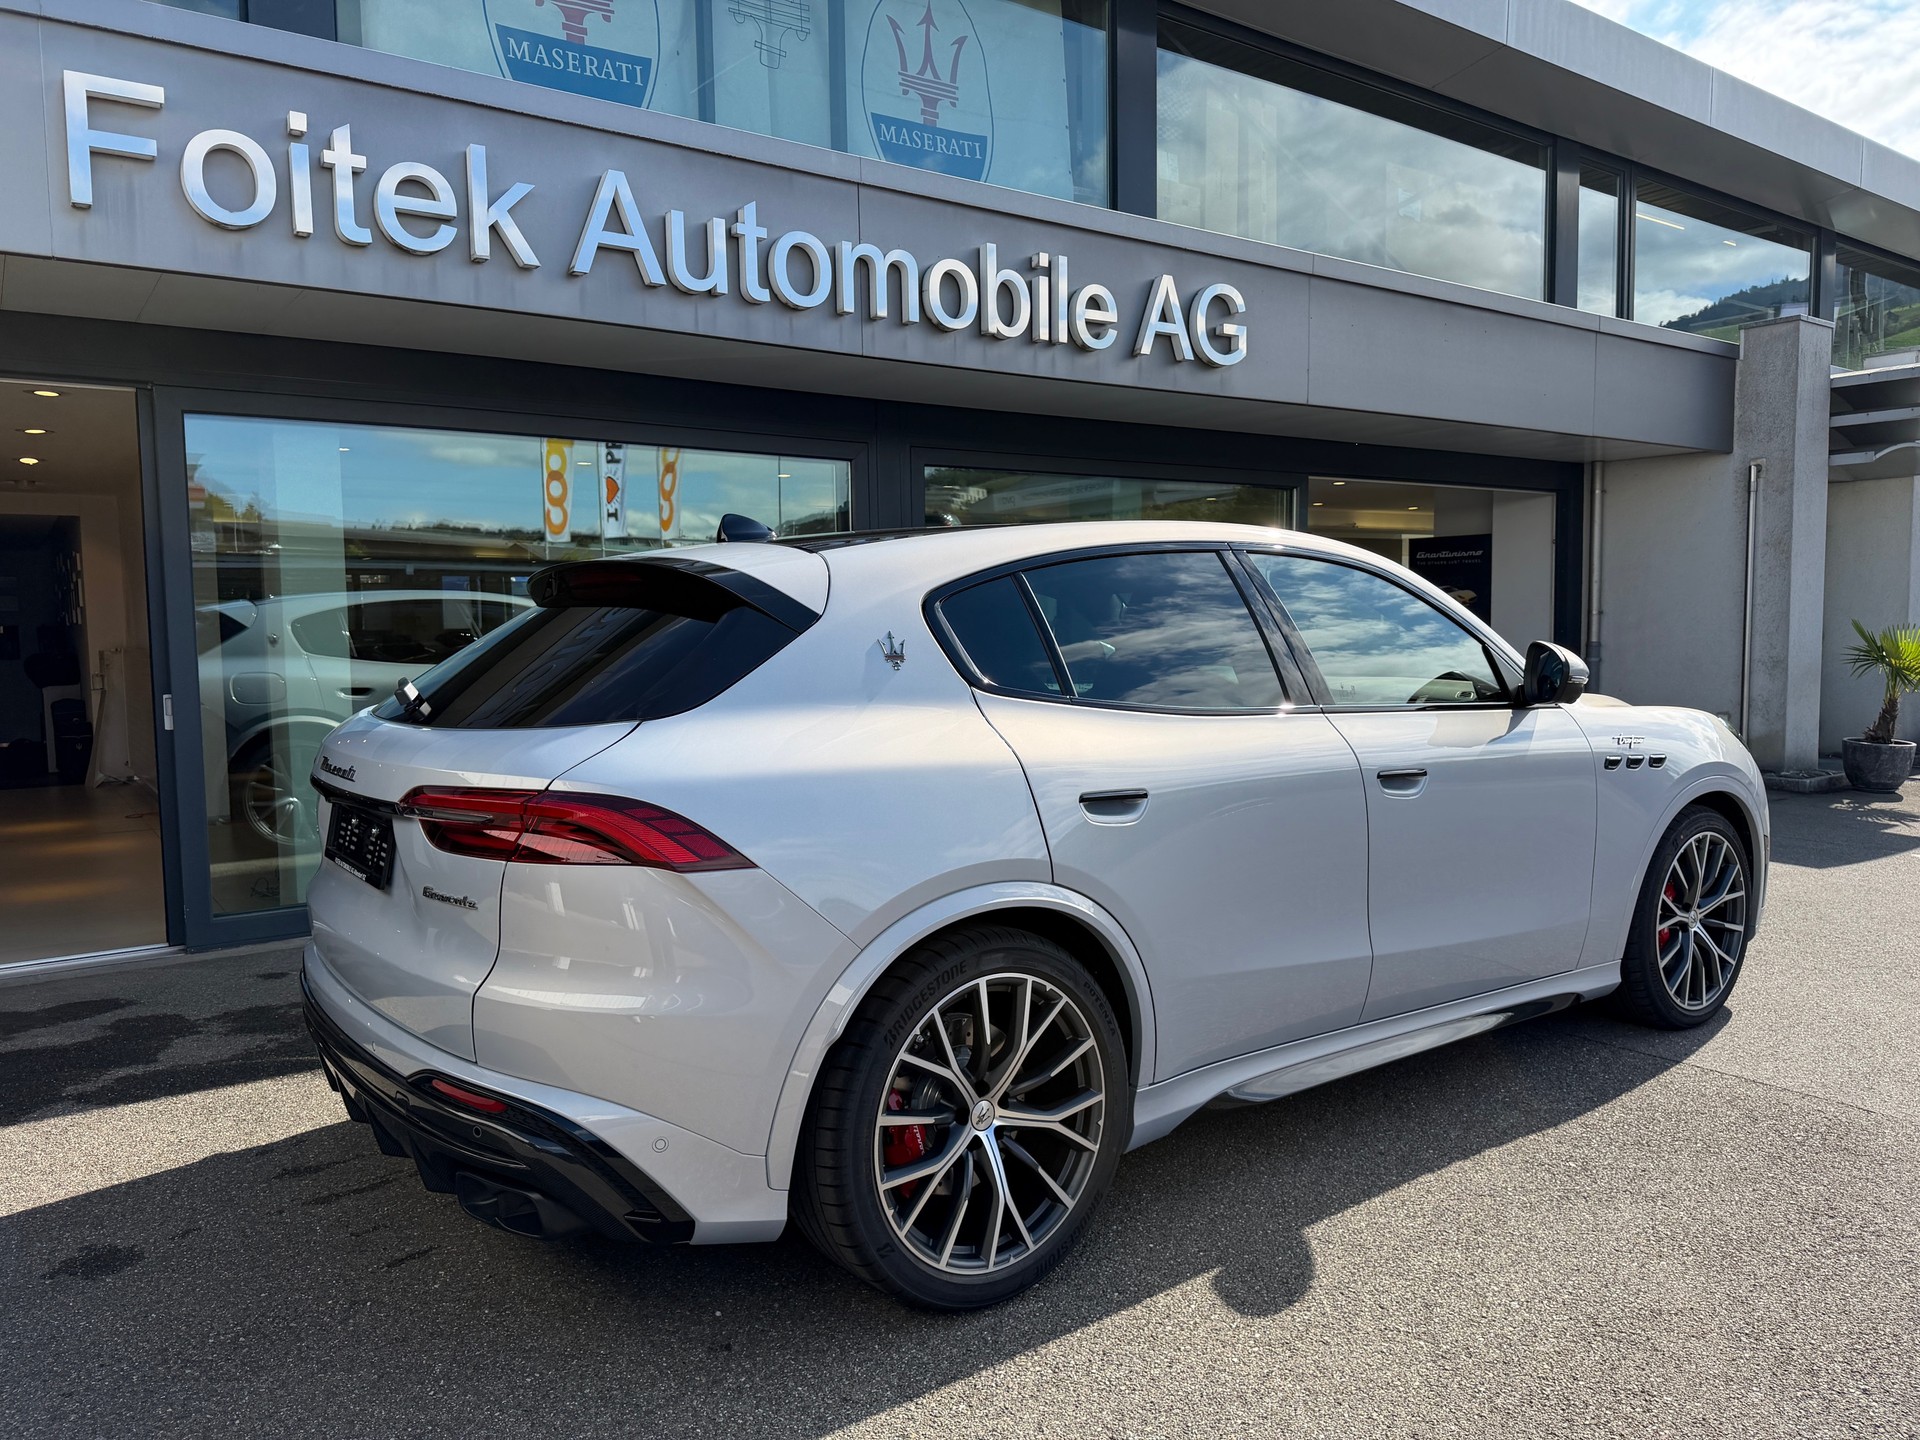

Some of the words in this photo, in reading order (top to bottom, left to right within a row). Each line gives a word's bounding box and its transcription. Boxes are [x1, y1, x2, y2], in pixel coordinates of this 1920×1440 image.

[506, 36, 644, 87] MASERATI
[879, 123, 983, 160] MASERATI
[63, 69, 541, 270] Foitek
[568, 169, 1118, 352] Automobile
[1132, 274, 1248, 368] AG
[607, 508, 619, 523] I
[1416, 550, 1484, 559] GranTurismo
[884, 960, 968, 1049] BRIDGESTONE
[1083, 981, 1118, 1037] POTENZA
